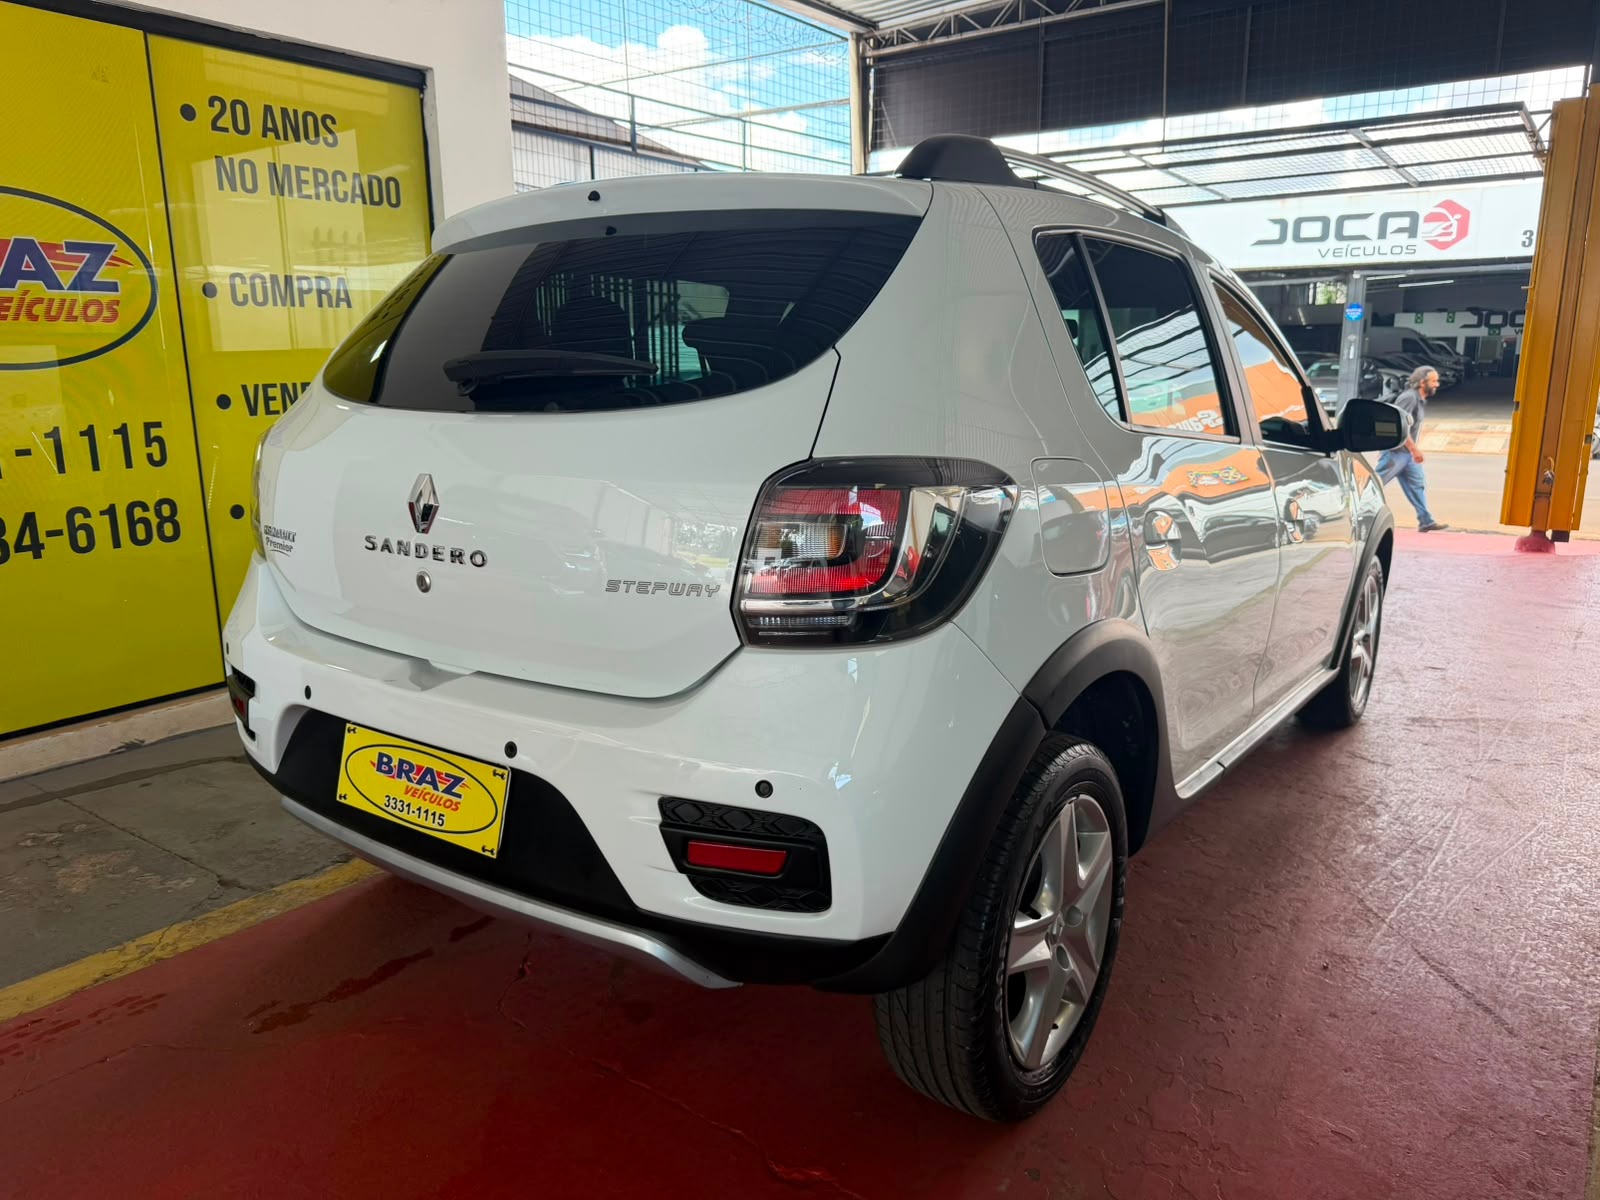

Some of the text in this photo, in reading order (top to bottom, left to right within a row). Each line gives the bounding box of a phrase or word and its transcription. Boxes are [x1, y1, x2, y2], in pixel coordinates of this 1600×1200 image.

[208, 95, 339, 148] 20 ANOS
[214, 155, 402, 209] NO MERCADO
[1251, 210, 1420, 247] JOCA
[0, 236, 120, 293] AZ
[1317, 242, 1417, 259] VEÍCULOS
[0, 289, 120, 323] EÍCULOS
[229, 272, 353, 309] COMPRA
[240, 381, 311, 417] VEN
[0, 421, 168, 479] -1115
[364, 535, 488, 568] SANDERO
[605, 579, 721, 598] STEPWAY
[375, 751, 466, 799] BRAZ
[384, 794, 446, 827] 3331-1115
[403, 784, 462, 812] VEÍCULOS
